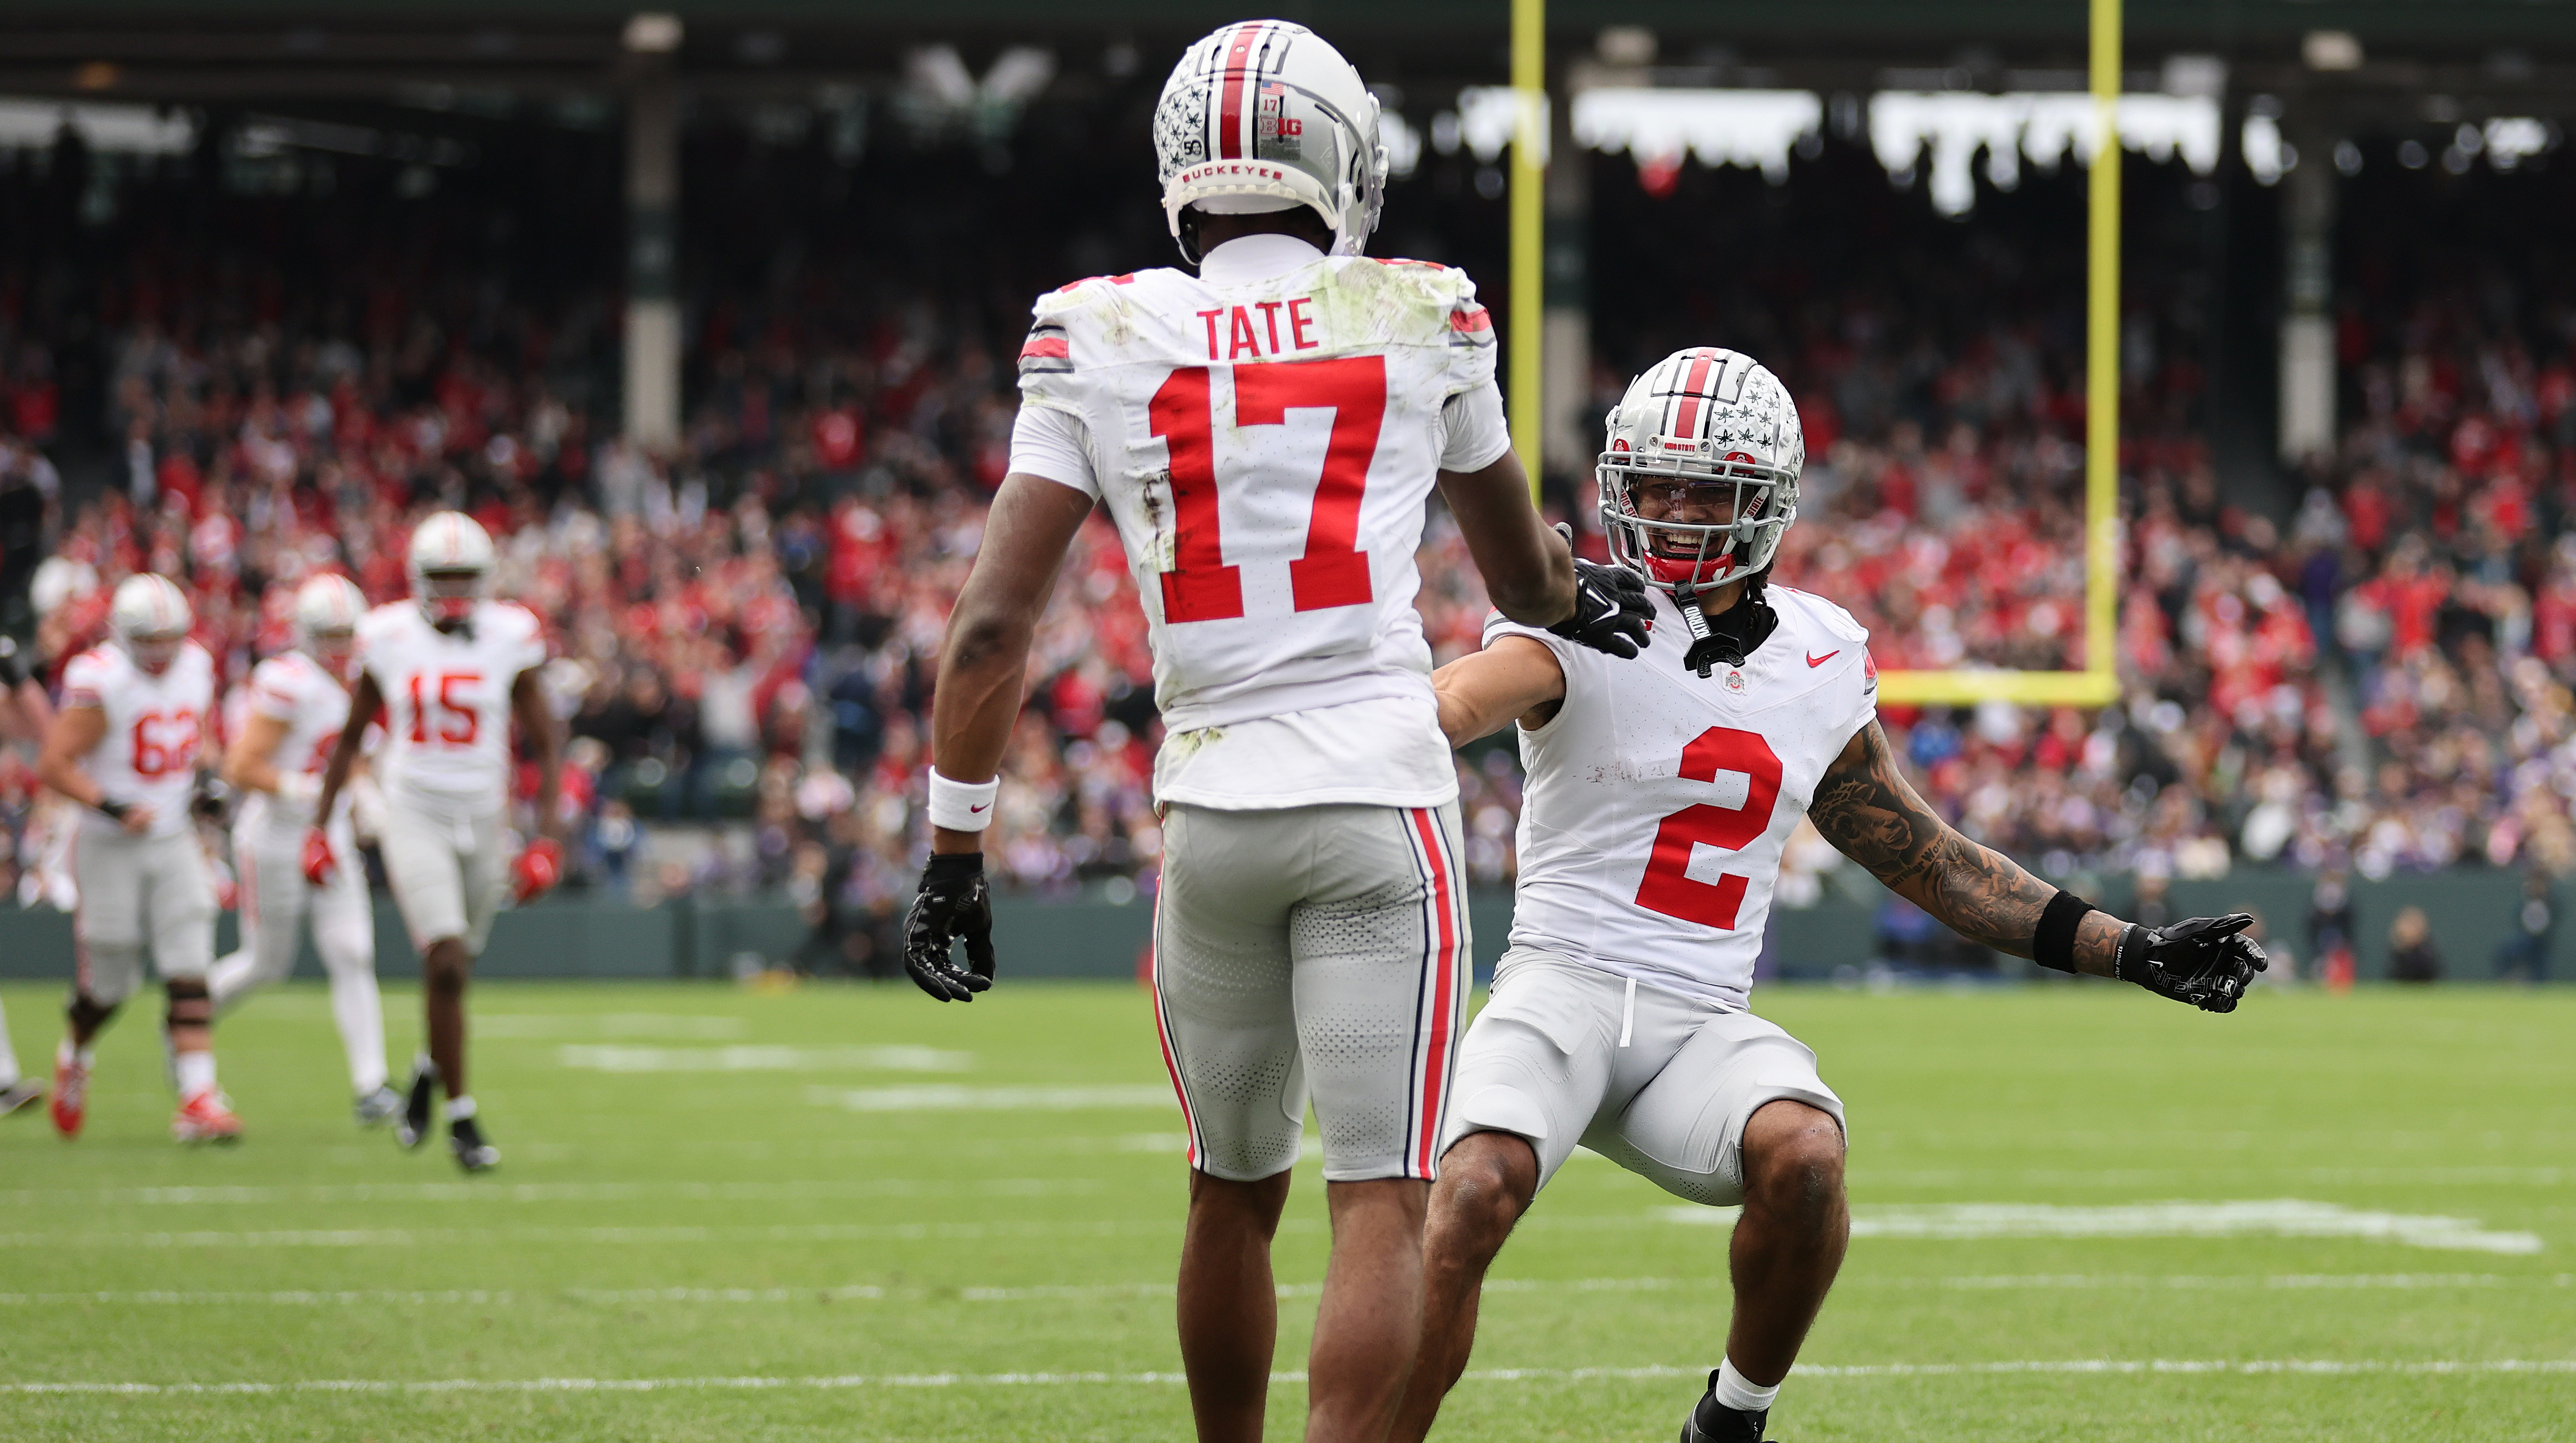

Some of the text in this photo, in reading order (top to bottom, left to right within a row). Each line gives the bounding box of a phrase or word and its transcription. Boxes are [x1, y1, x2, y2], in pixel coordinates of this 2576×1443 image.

[1263, 98, 1278, 112] 17
[1182, 165, 1283, 183] BUCKEYES
[1196, 297, 1319, 361] TATE
[1678, 444, 1696, 452] STATE
[1148, 355, 1387, 625] 17
[1747, 495, 1765, 517] STATE
[1684, 606, 1711, 640] NXTRND
[410, 673, 482, 743] 15
[132, 708, 200, 777] 62
[1635, 725, 1783, 931] 2
[2115, 946, 2124, 966] Hearts
